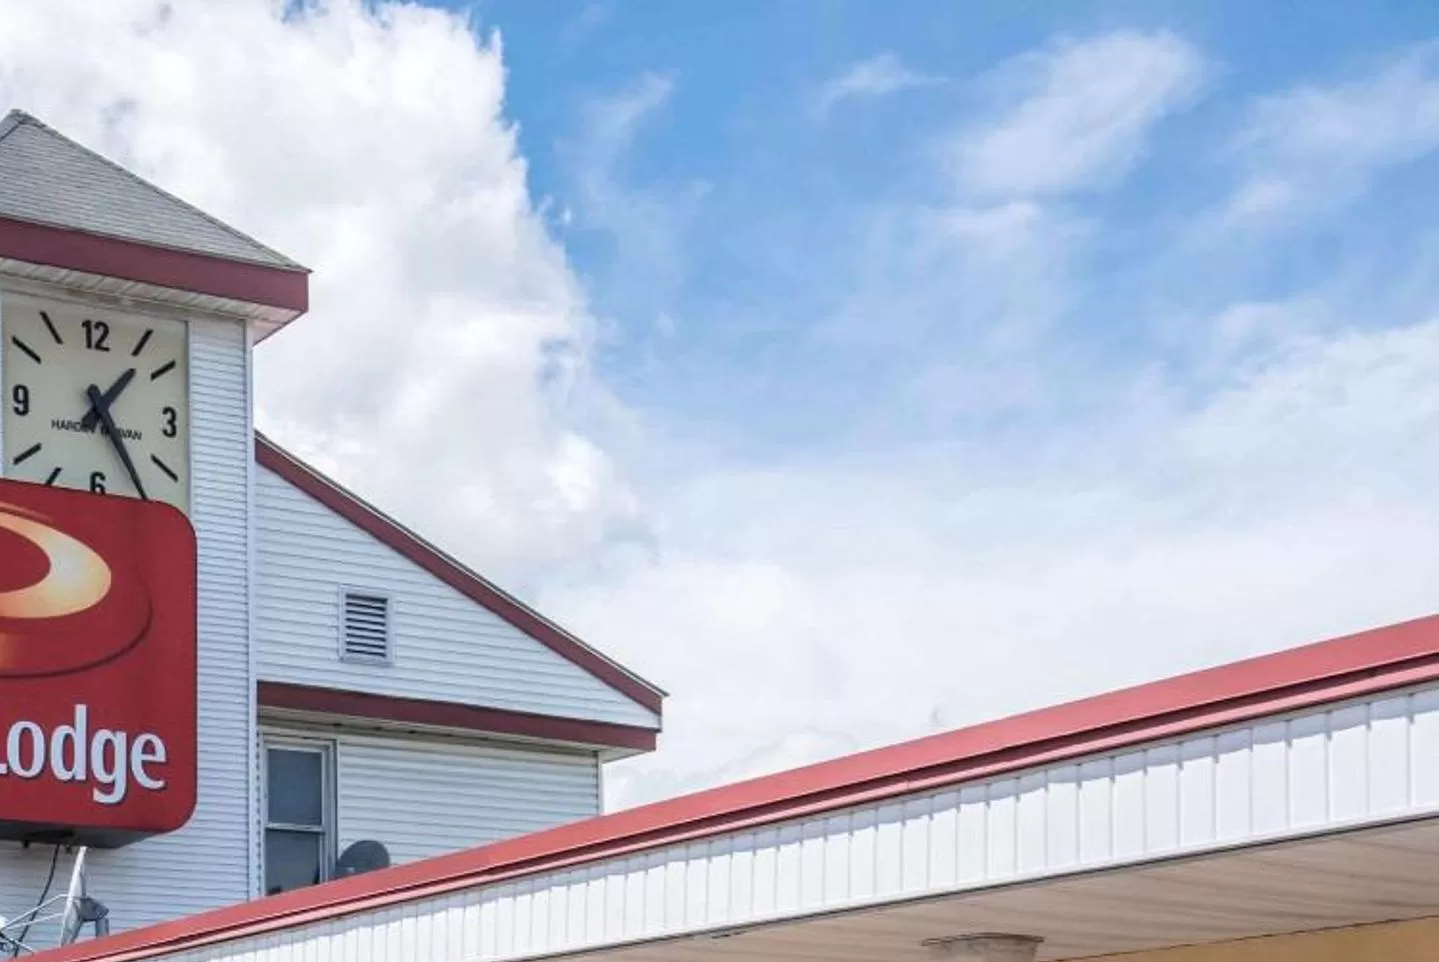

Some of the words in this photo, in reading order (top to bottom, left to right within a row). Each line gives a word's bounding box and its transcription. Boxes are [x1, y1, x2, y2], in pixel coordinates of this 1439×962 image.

[81, 319, 111, 352] 12
[12, 385, 30, 416] 9
[162, 407, 177, 437] 3
[90, 472, 106, 495] 6
